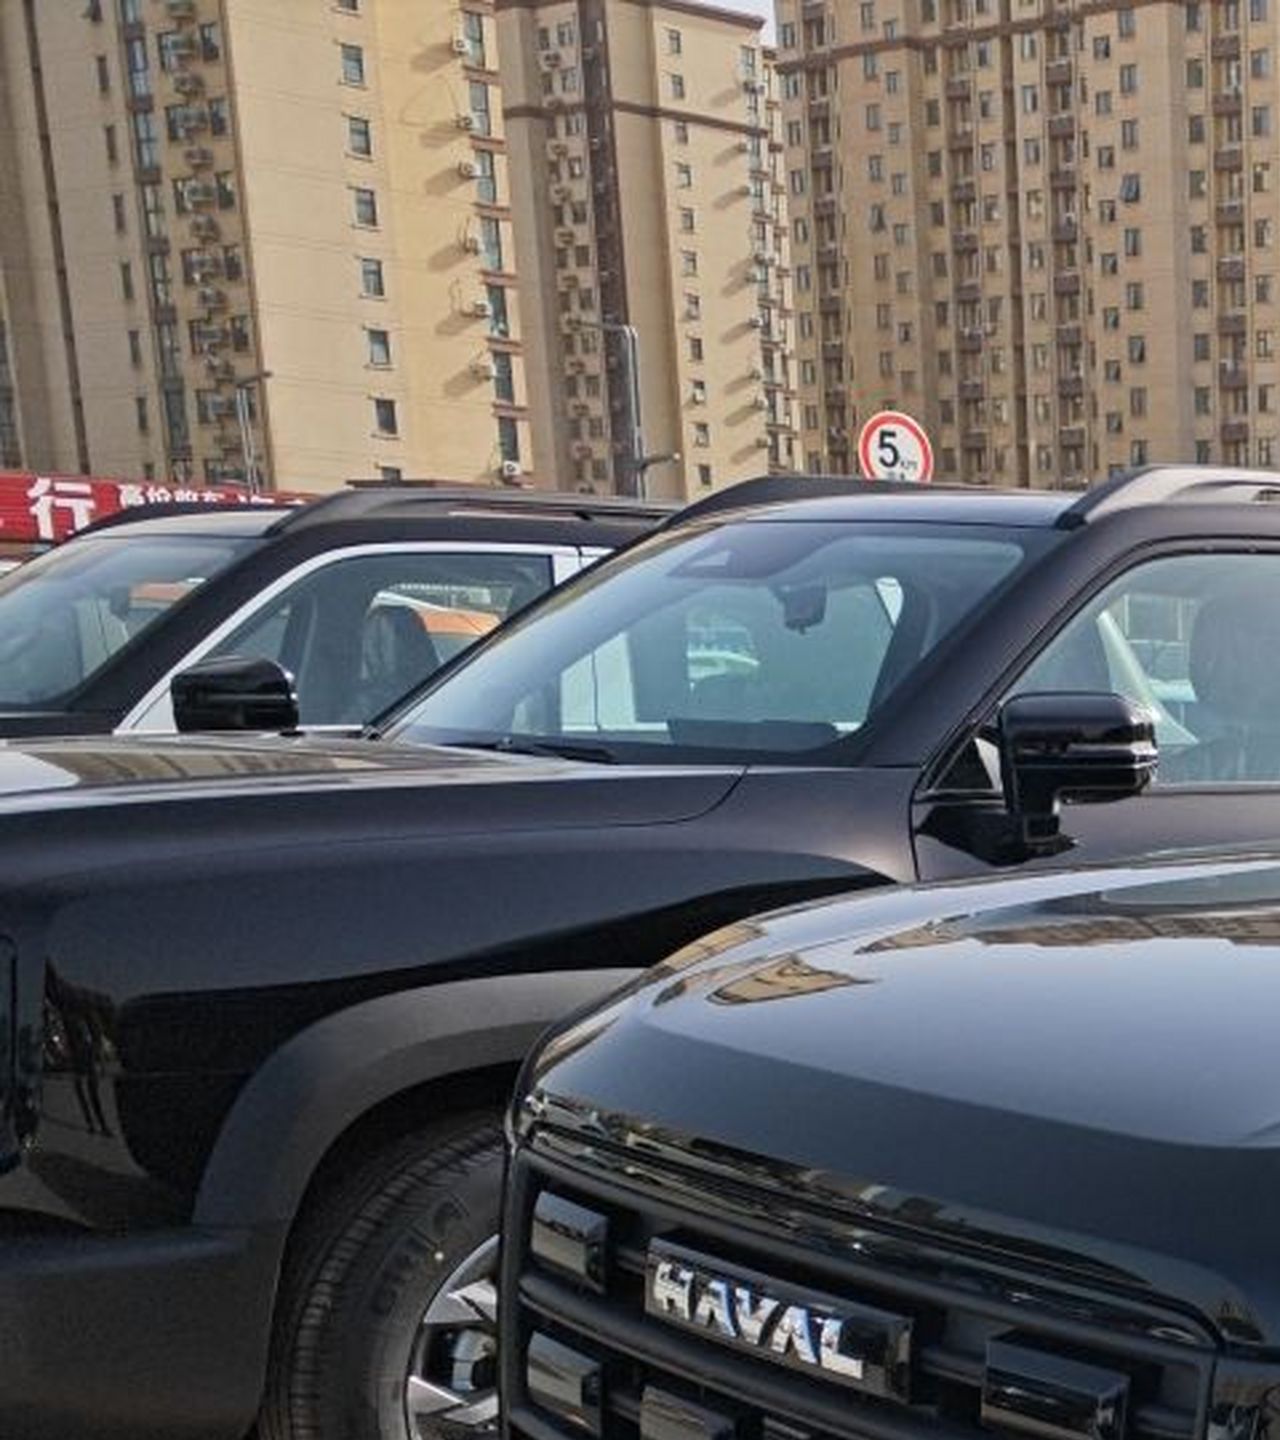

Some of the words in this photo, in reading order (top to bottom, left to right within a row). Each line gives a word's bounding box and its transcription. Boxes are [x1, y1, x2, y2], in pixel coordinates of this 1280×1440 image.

[879, 430, 900, 467] 5
[27, 478, 96, 539] 行
[653, 1262, 864, 1379] HAVAL
